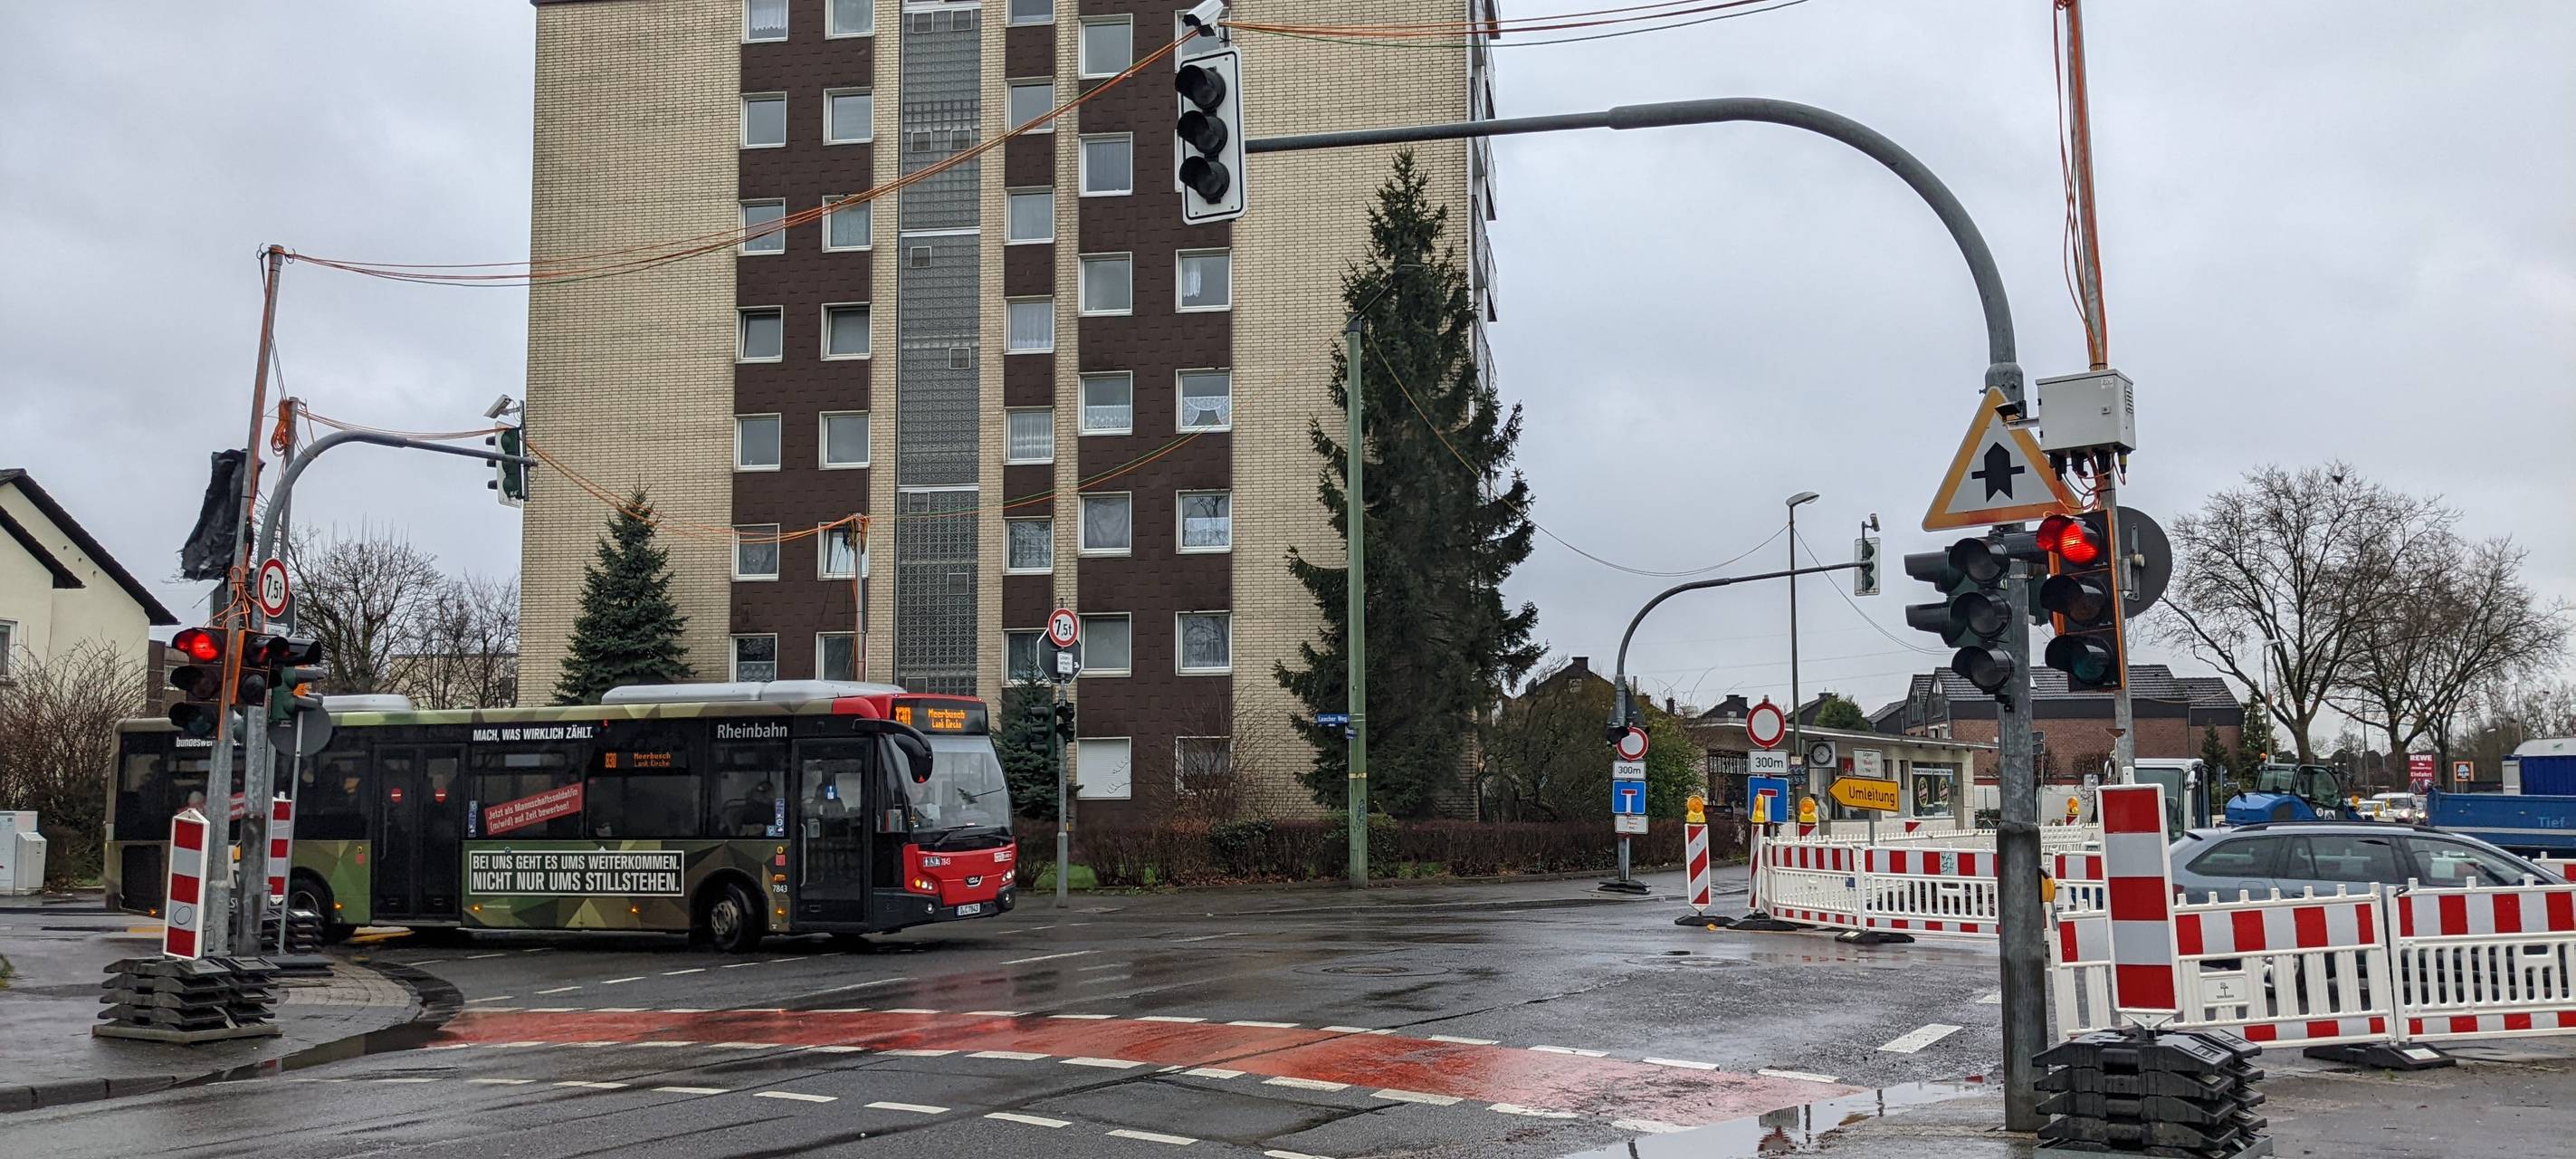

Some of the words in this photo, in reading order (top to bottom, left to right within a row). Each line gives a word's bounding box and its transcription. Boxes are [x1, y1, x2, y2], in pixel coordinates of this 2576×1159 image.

[266, 573, 282, 599] 7,5t
[1054, 619, 1073, 636] 7,5t
[928, 708, 965, 719] Meerbusch
[473, 729, 500, 742] MACH,
[502, 728, 520, 741] WAS
[523, 726, 563, 740] WIRKLICH
[566, 724, 593, 740] ZÄHLT.
[718, 723, 787, 739] Rheinbahn
[605, 753, 616, 768] 830
[1756, 757, 1783, 768] 300m
[1617, 766, 1641, 774] 300m
[1848, 786, 1895, 807] Umleitung
[489, 808, 503, 819] Jetzt
[505, 806, 514, 815] als
[514, 814, 524, 824] auf
[526, 809, 538, 820] Zeit
[538, 801, 570, 818] bewerben!
[472, 856, 489, 870] BEI
[491, 856, 512, 869] UNS
[516, 856, 540, 869] GEHT
[545, 856, 558, 869] ES
[561, 856, 585, 869] UMS
[588, 856, 680, 870] WEITERKOMMEN.
[941, 857, 951, 866] 7843
[472, 872, 512, 890] NICHT
[517, 872, 544, 890] NUR
[549, 872, 580, 891] UMS
[586, 872, 680, 892] STILLSTEHEN.
[772, 885, 788, 893] 7843
